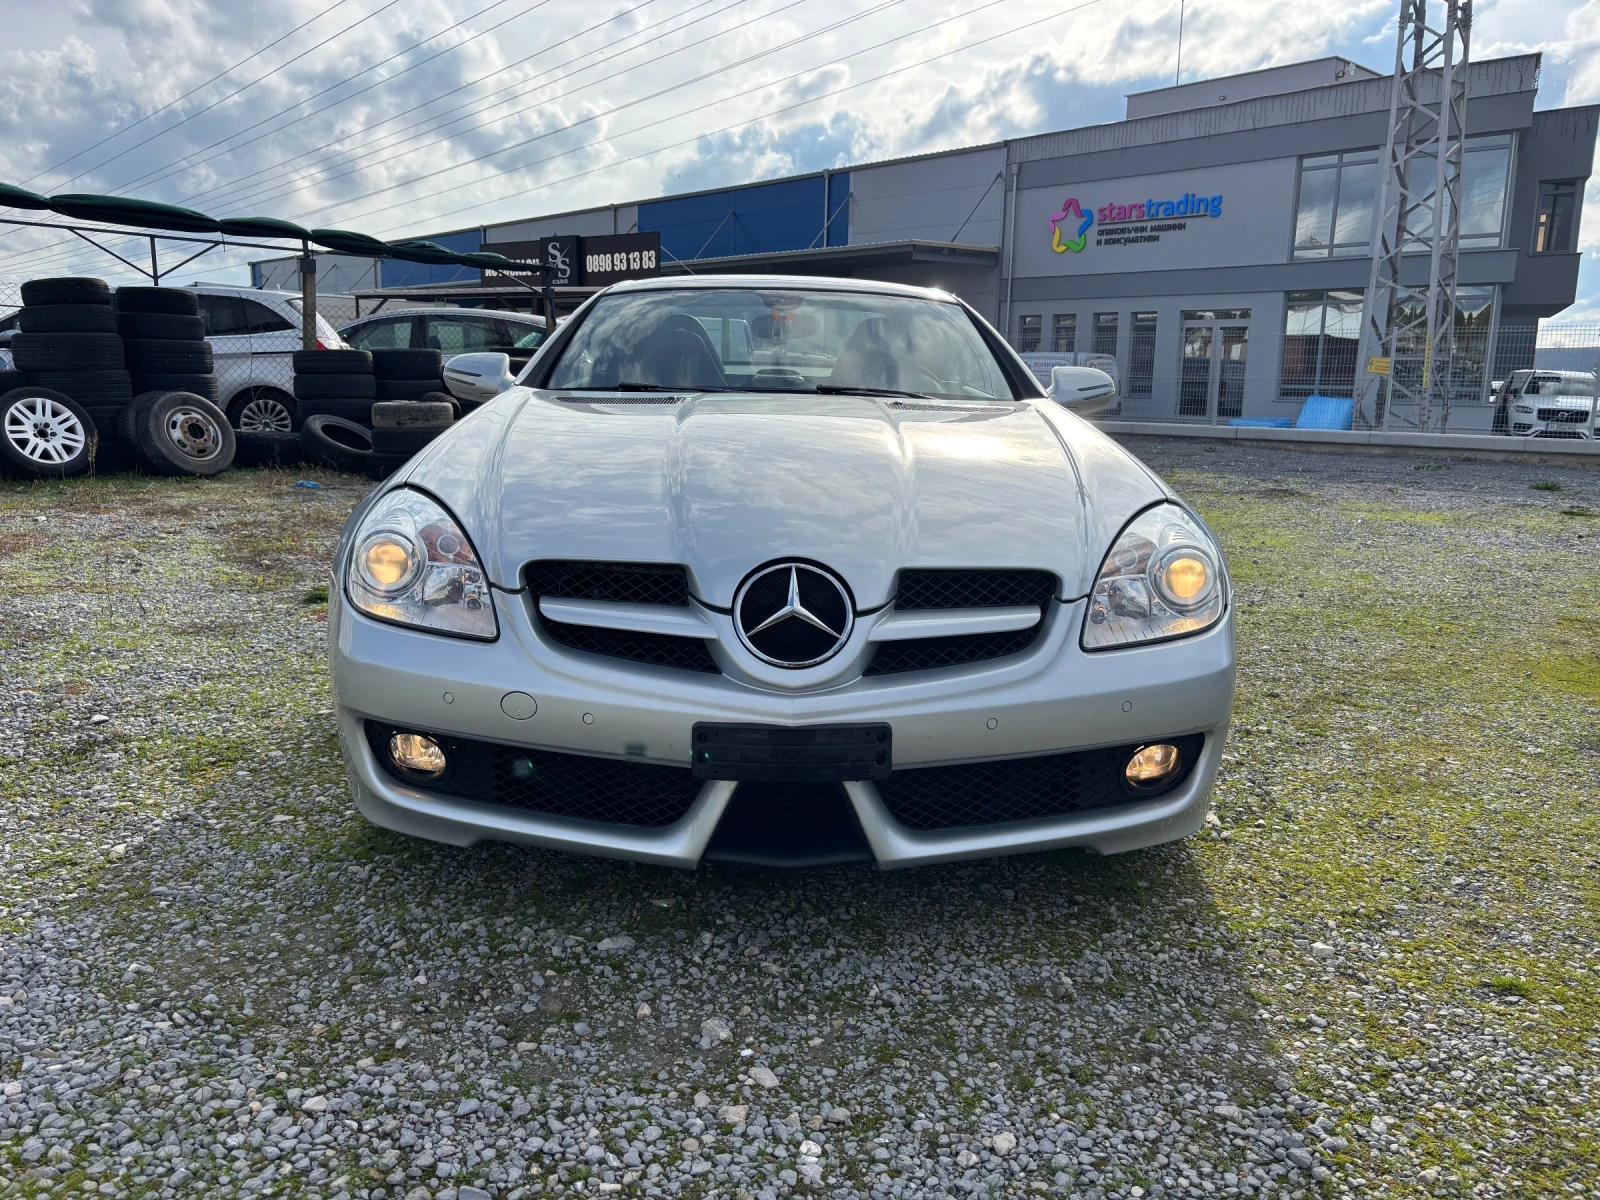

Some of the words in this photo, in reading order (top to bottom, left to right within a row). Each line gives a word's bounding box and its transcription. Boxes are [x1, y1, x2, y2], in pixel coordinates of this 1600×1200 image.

[1097, 193, 1222, 222] starstrading
[1097, 225, 1148, 237] опаковъчни
[1150, 222, 1186, 233] машини
[1096, 238, 1102, 246] и
[1104, 234, 1160, 246] консумативи
[586, 254, 612, 273] 0898
[613, 252, 627, 271] 93
[628, 251, 640, 270] 13
[642, 249, 656, 269] 83
